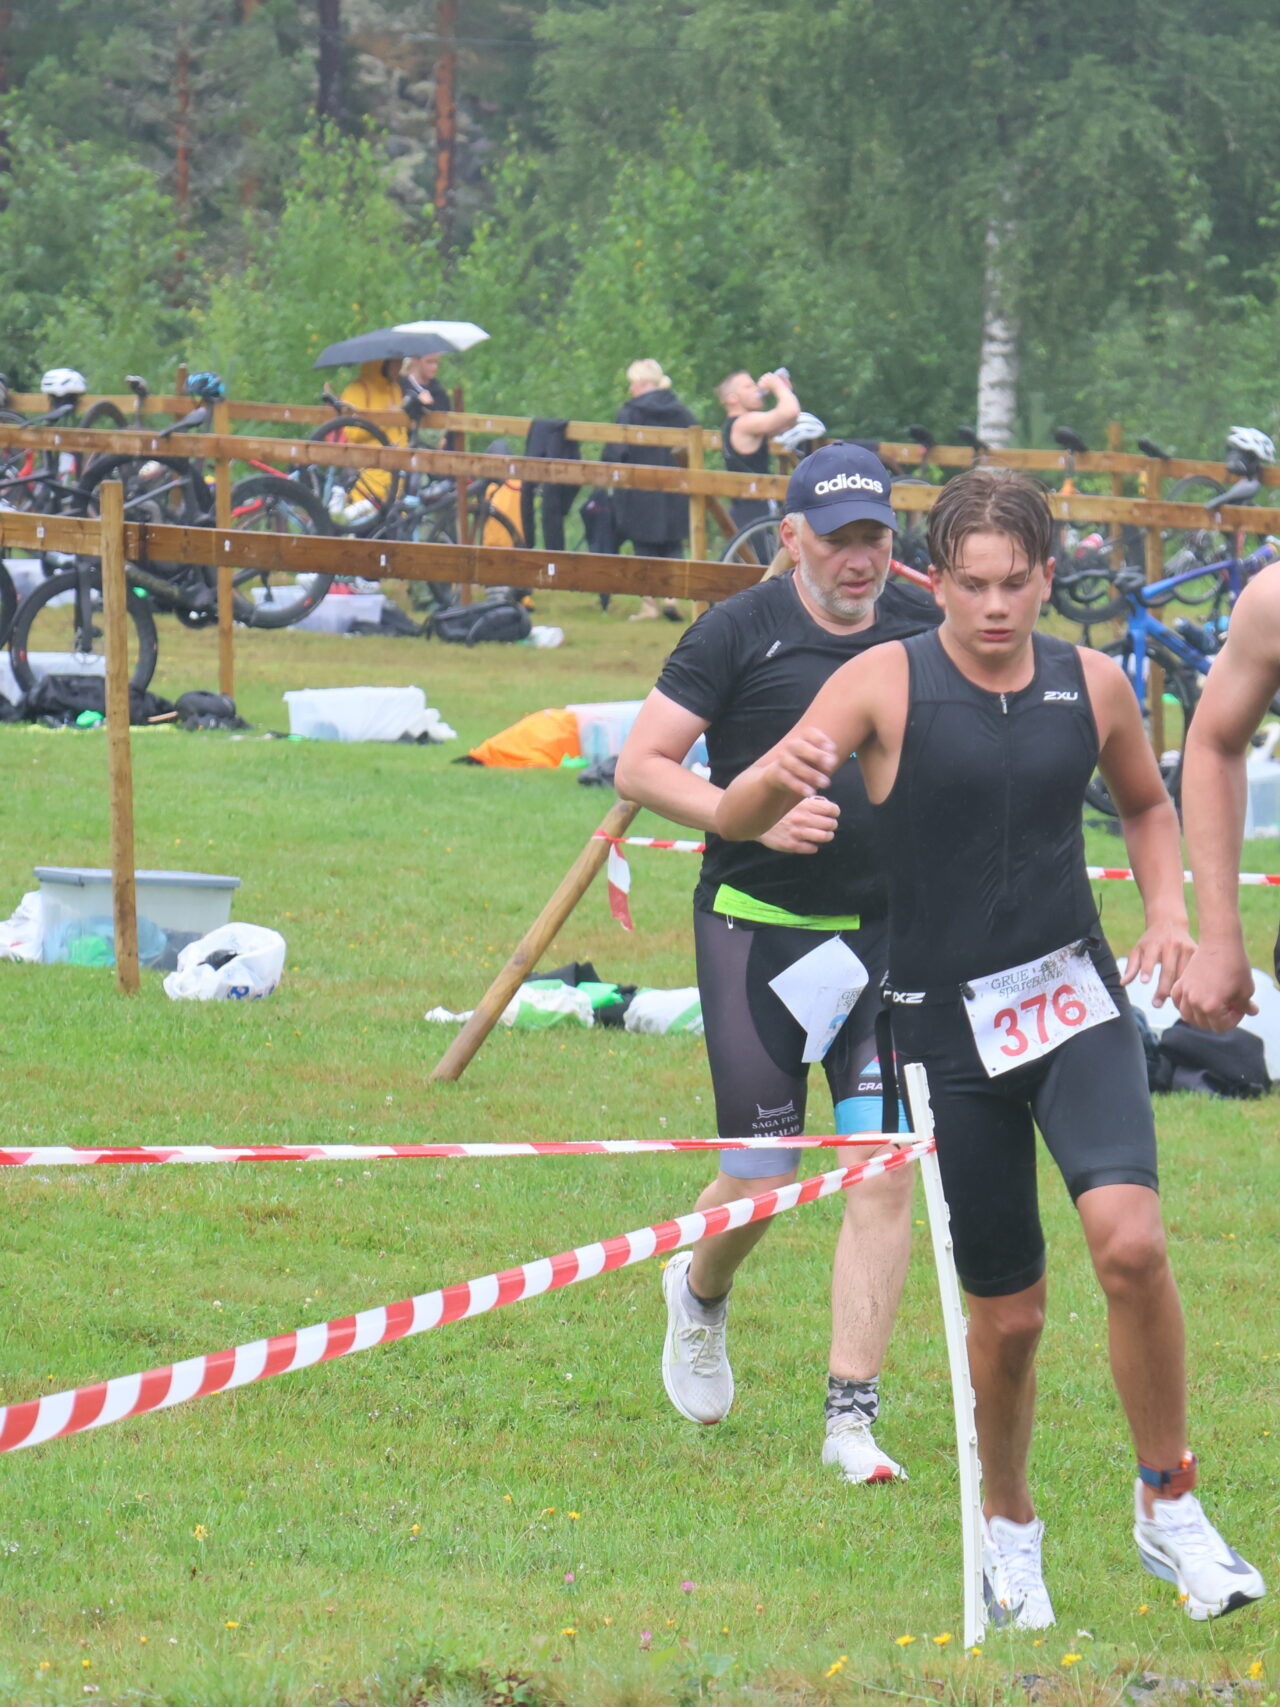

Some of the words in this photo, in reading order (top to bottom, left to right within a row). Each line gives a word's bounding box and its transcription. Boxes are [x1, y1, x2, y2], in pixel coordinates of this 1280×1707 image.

[814, 473, 884, 495] adidas
[1043, 691, 1079, 701] 2XU
[991, 968, 1031, 990] GRUE
[993, 984, 1087, 1057] 376
[752, 1119, 780, 1130] SAGA
